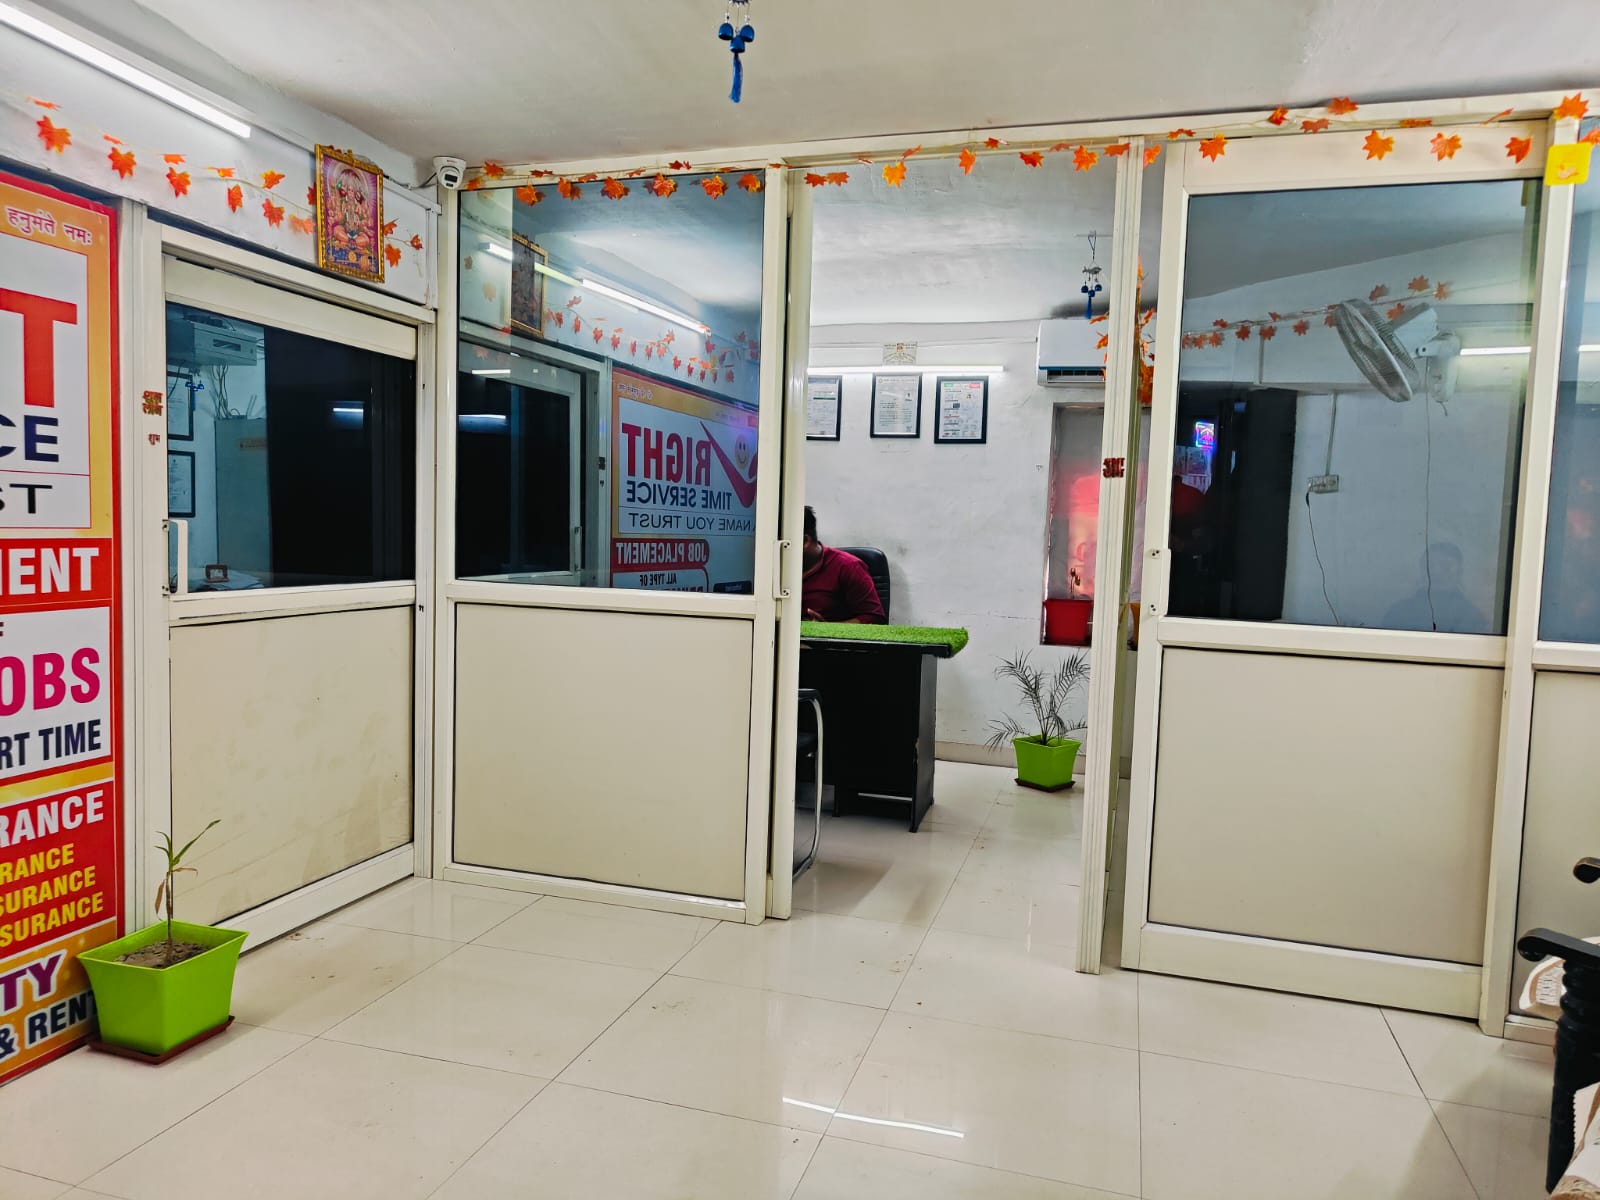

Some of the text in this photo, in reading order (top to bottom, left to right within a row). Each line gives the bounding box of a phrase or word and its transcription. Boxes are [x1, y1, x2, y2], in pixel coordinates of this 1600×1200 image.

[63, 224, 92, 244] नमः
[0, 482, 53, 514] T
[0, 547, 99, 596] ENT
[38, 718, 101, 761] TIME
[0, 842, 74, 885] RANCE
